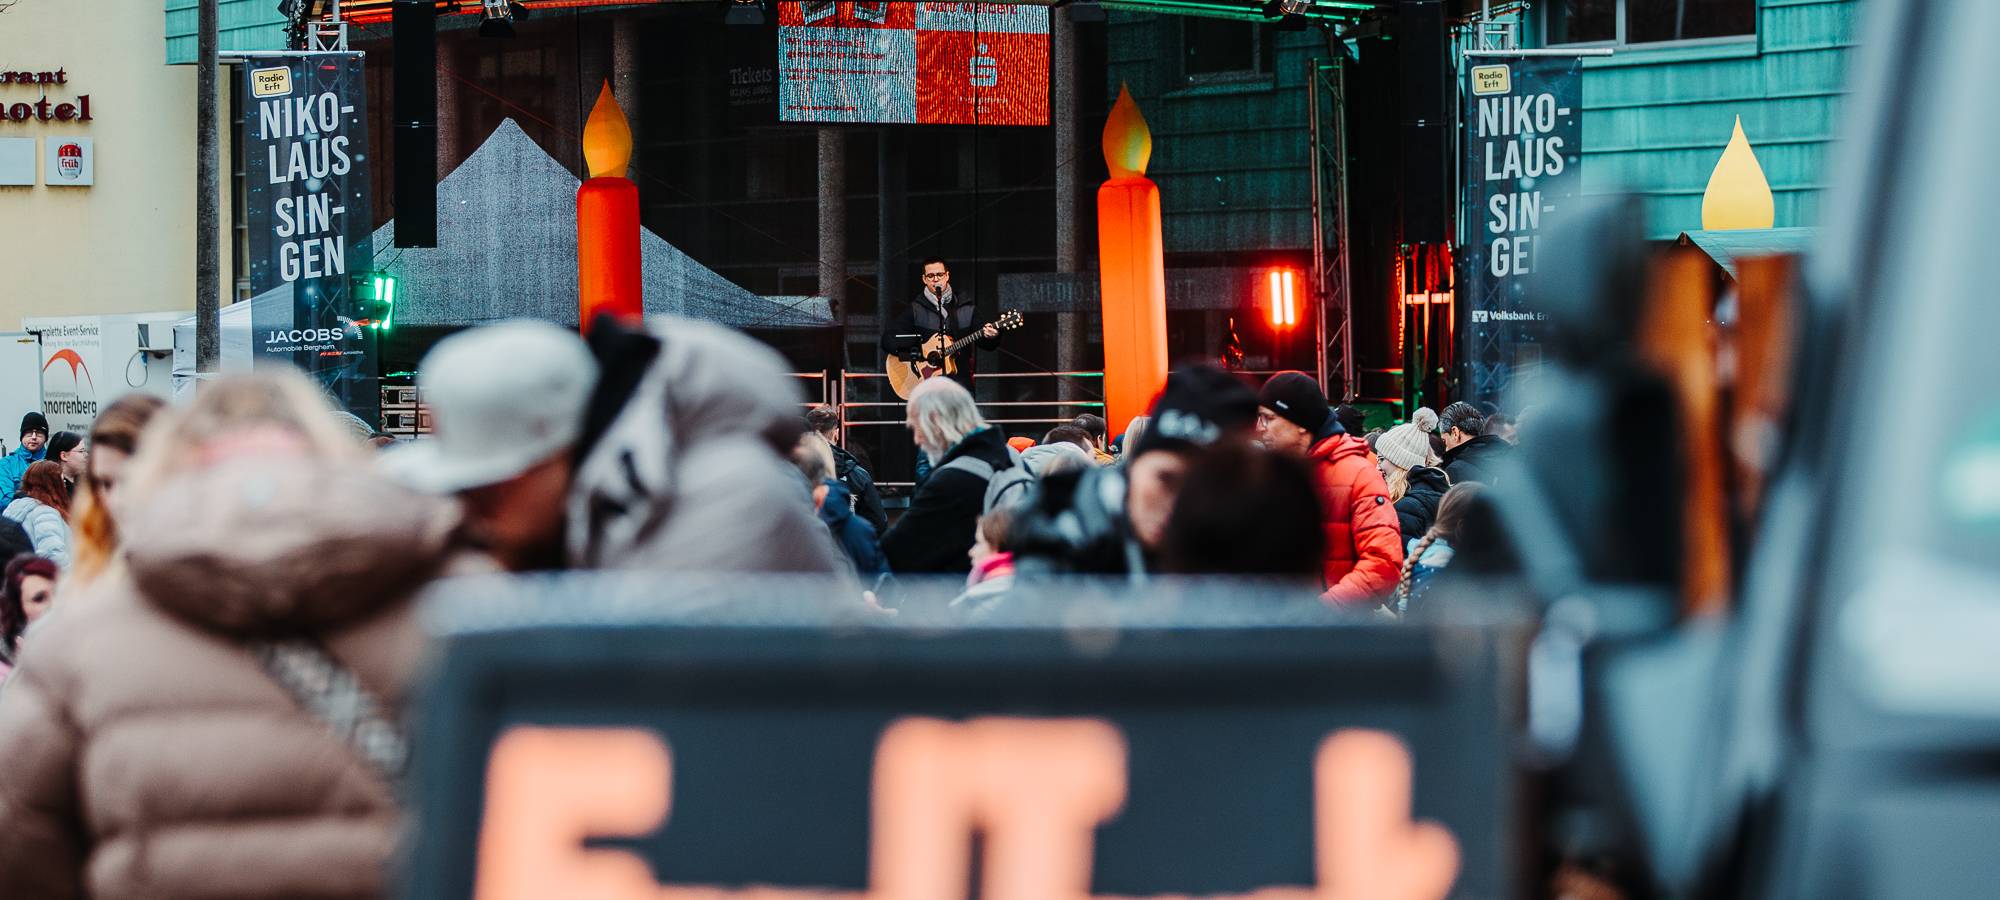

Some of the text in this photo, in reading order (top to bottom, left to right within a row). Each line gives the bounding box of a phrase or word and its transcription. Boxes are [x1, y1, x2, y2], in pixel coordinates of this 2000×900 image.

[0, 66, 68, 84] rant
[258, 73, 284, 83] Radio
[729, 66, 773, 85] Tickets
[1478, 71, 1503, 80] Radio
[1483, 80, 1499, 88] Erft
[264, 83, 281, 91] Erft
[260, 91, 354, 140] NIKO-
[1478, 93, 1570, 137] NIKO-
[268, 135, 351, 184] LAUS
[1485, 136, 1564, 181] LAUS
[275, 192, 345, 238] SIN-
[1488, 191, 1555, 234] SIN-
[280, 235, 345, 282] GEN
[1489, 311, 1535, 320] Volksbank
[265, 327, 344, 344] JACOBS
[303, 344, 335, 352] Bergheim
